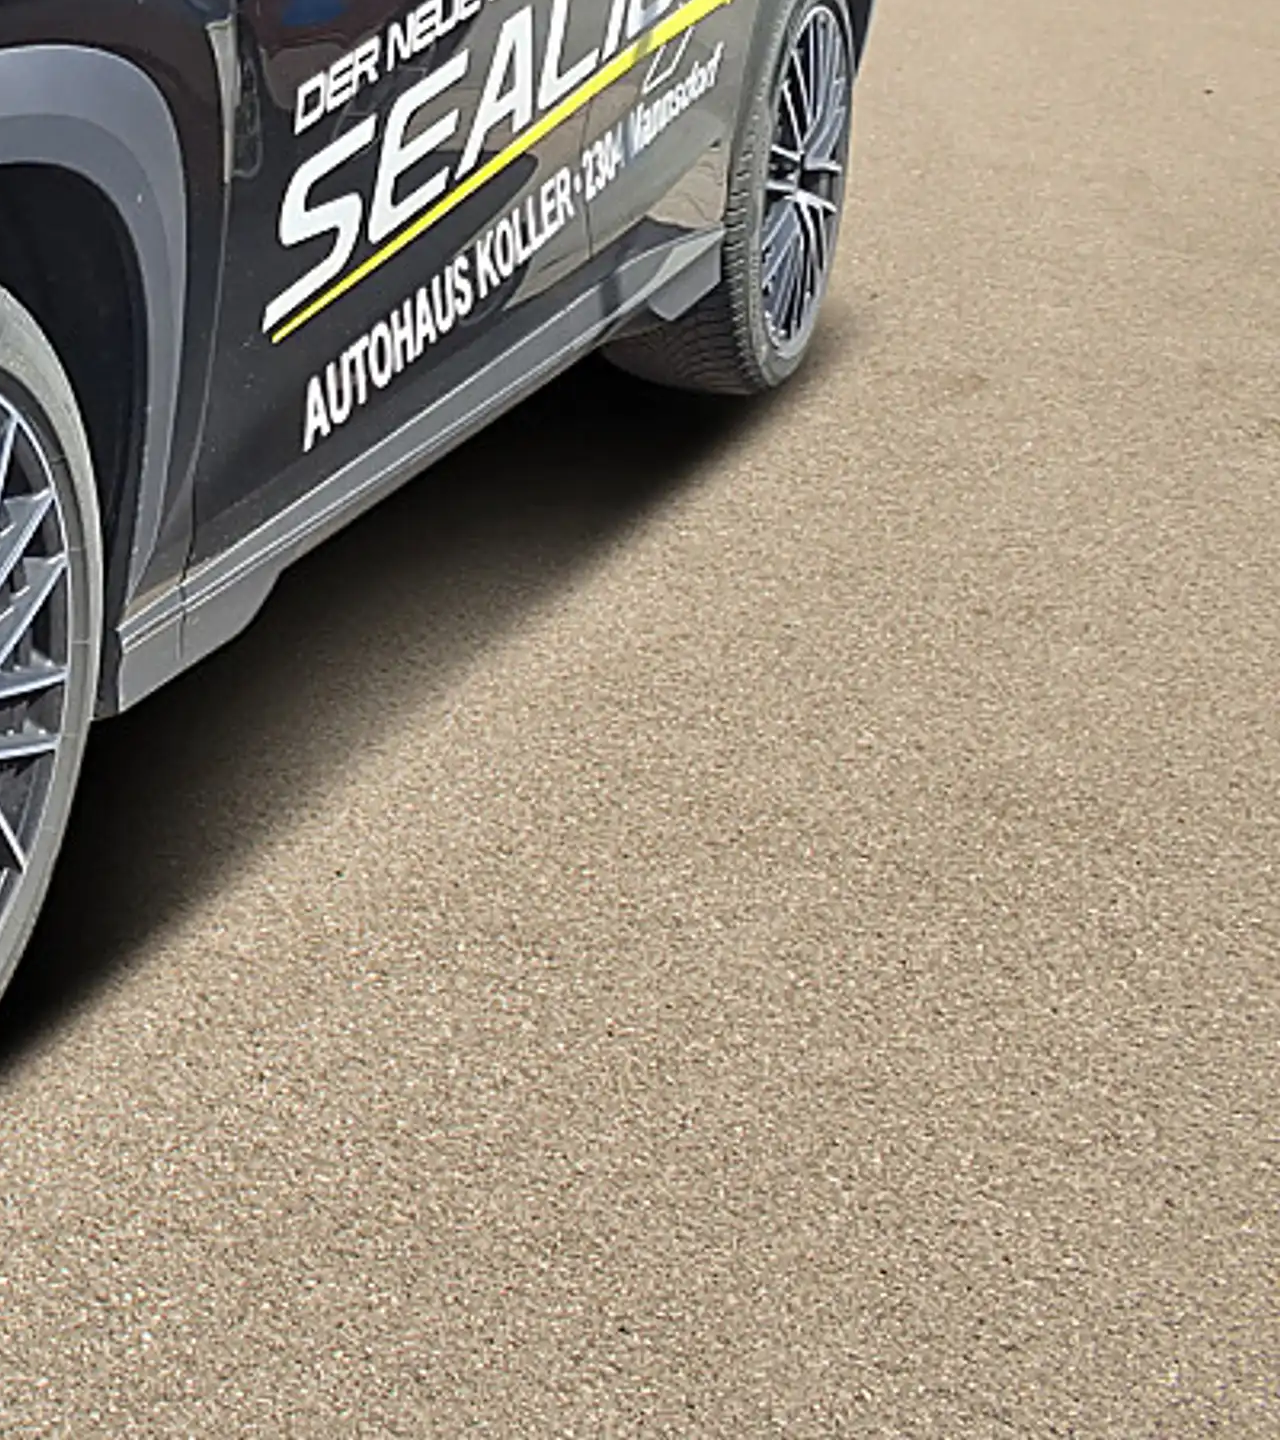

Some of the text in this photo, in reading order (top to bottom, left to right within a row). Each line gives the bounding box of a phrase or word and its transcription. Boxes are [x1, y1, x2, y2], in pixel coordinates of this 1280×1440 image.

[294, 35, 382, 136] DER
[303, 255, 473, 452] AUTOHAUS
[476, 165, 576, 299] KOLLER
